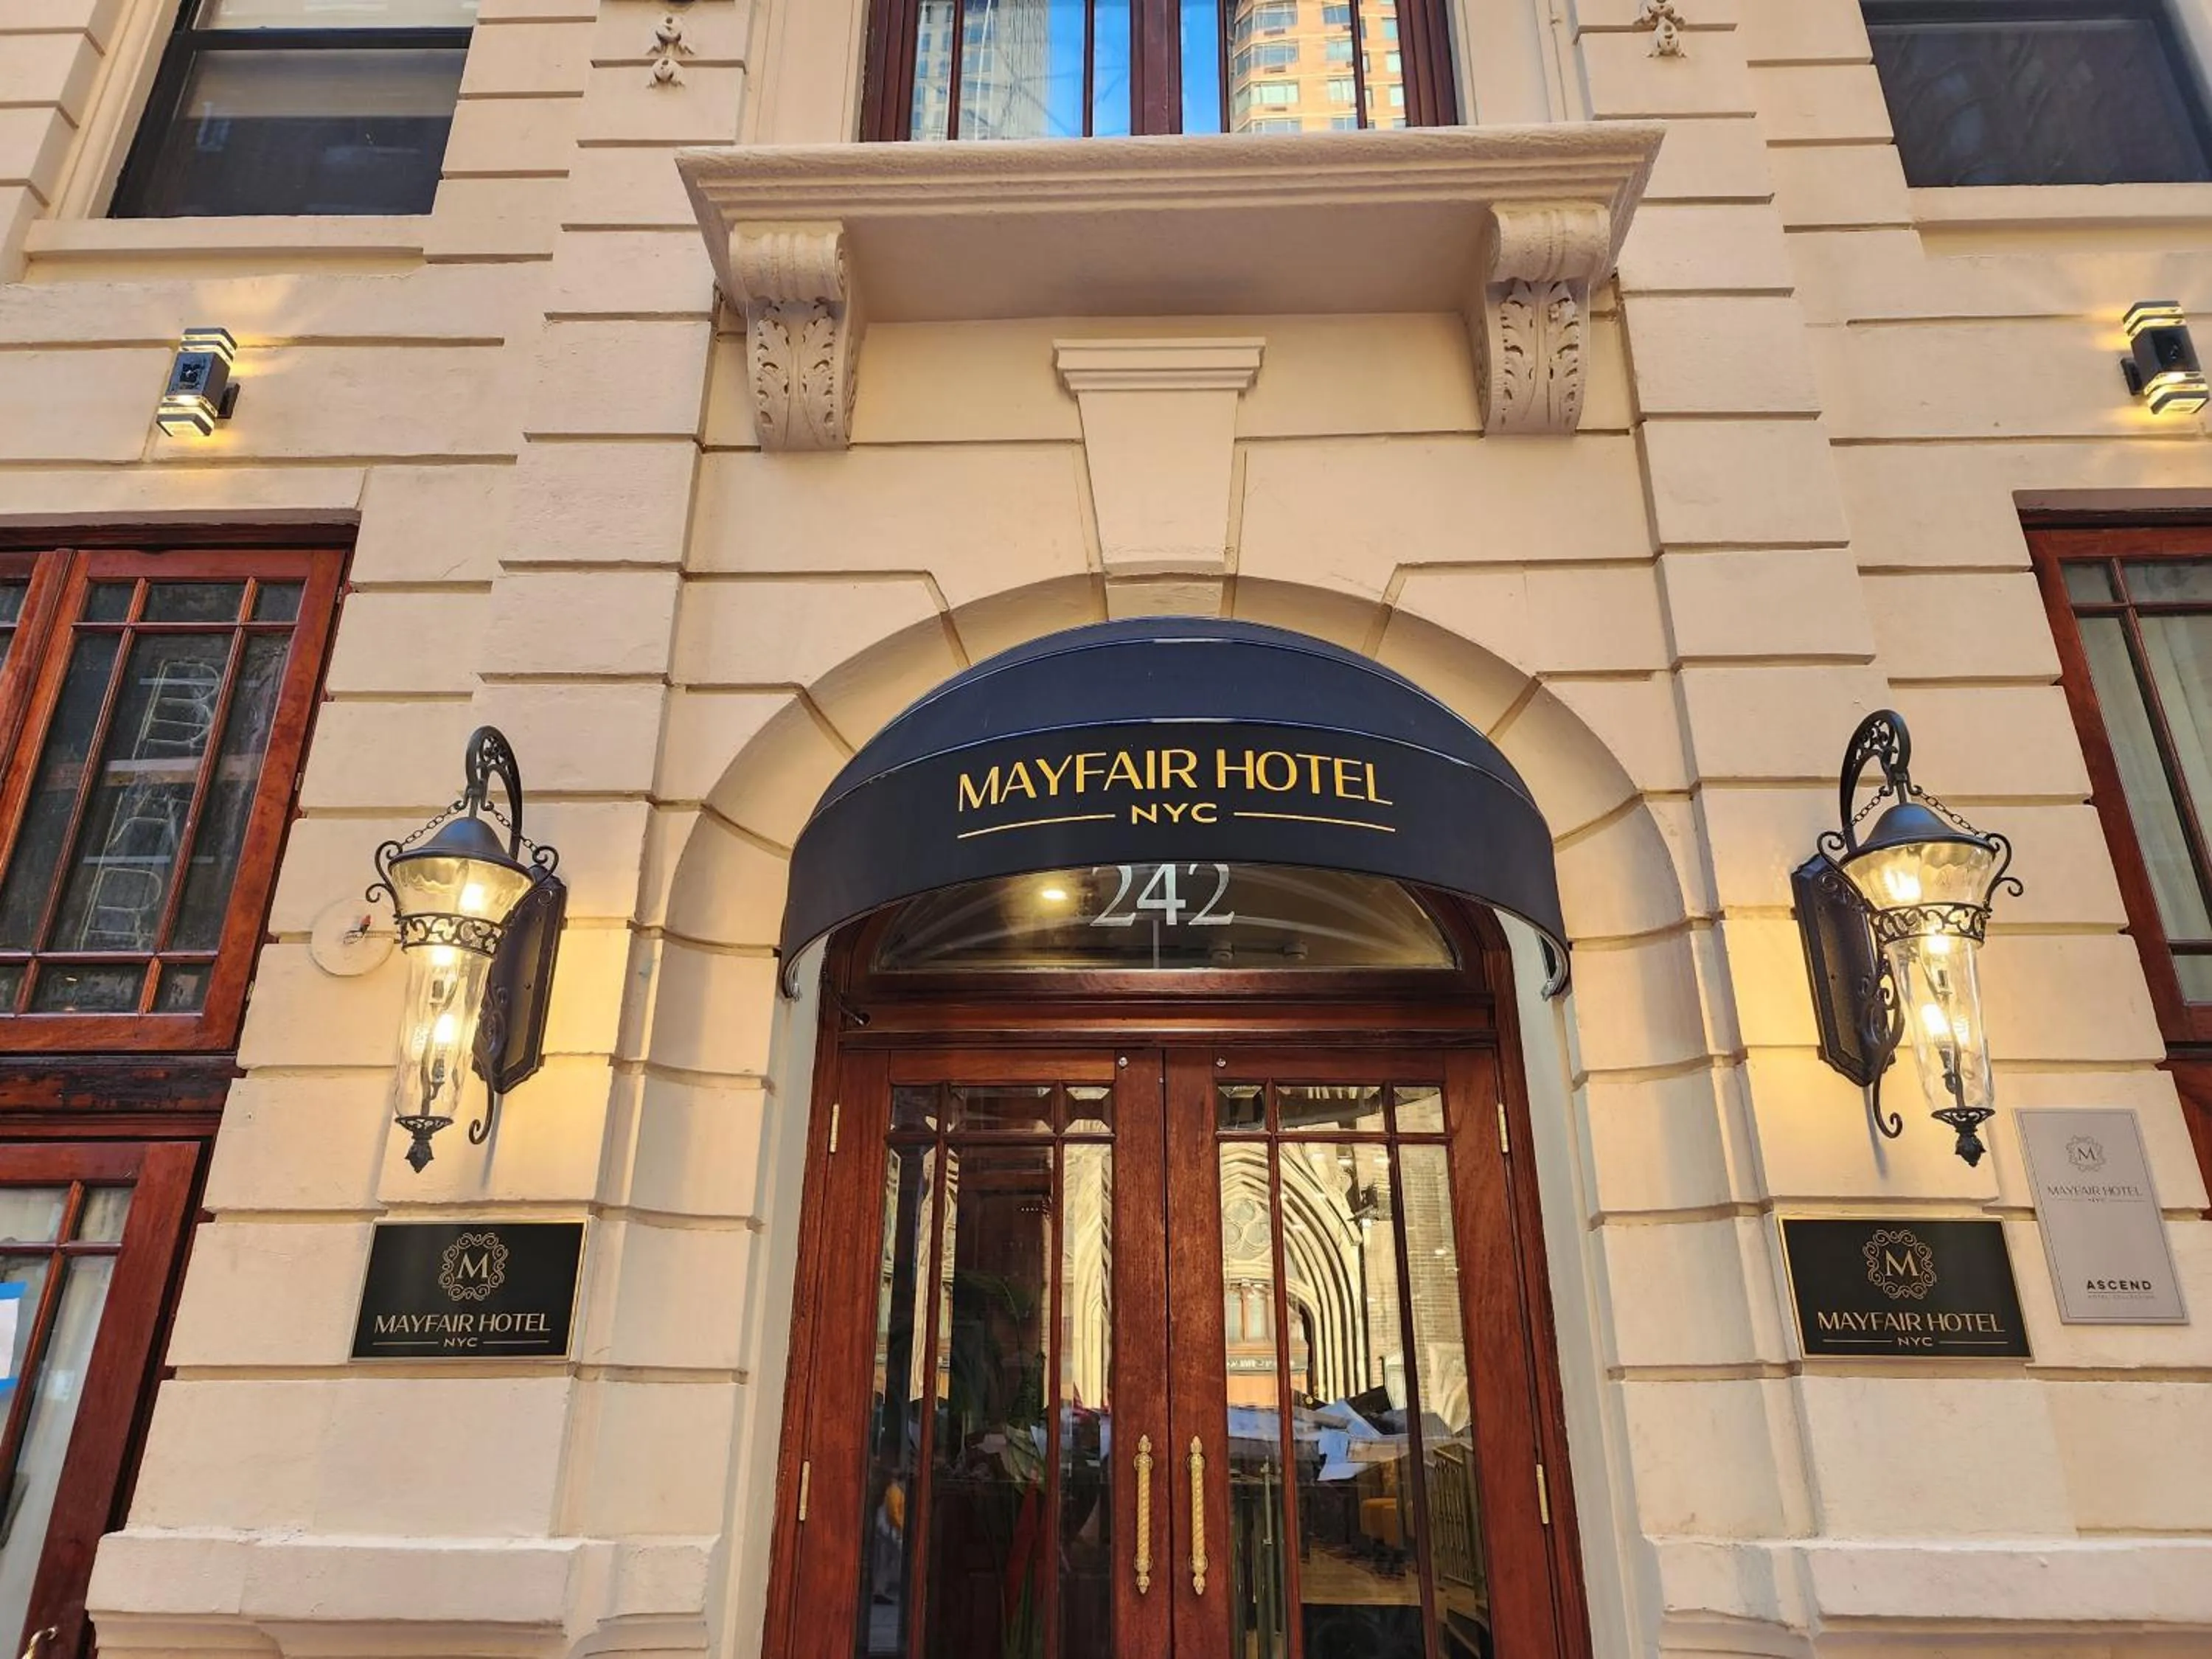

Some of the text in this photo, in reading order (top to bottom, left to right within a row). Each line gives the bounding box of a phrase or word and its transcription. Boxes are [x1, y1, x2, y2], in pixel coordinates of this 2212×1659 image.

[959, 748, 1393, 812] MAYFAIR HOTEL
[1131, 802, 1218, 824] NYC
[1090, 863, 1235, 927] 242
[2047, 1185, 2143, 1197] MAYFAIR HOTEL
[455, 1253, 489, 1279] M
[1885, 1249, 1919, 1277] M
[2087, 1279, 2152, 1290] ASCEND
[374, 1312, 552, 1334] MAYFAIR HOTEL
[1817, 1311, 2006, 1333] MAYFAIR HOTEL
[443, 1337, 479, 1348] NYC
[1897, 1336, 1934, 1347] NYC
